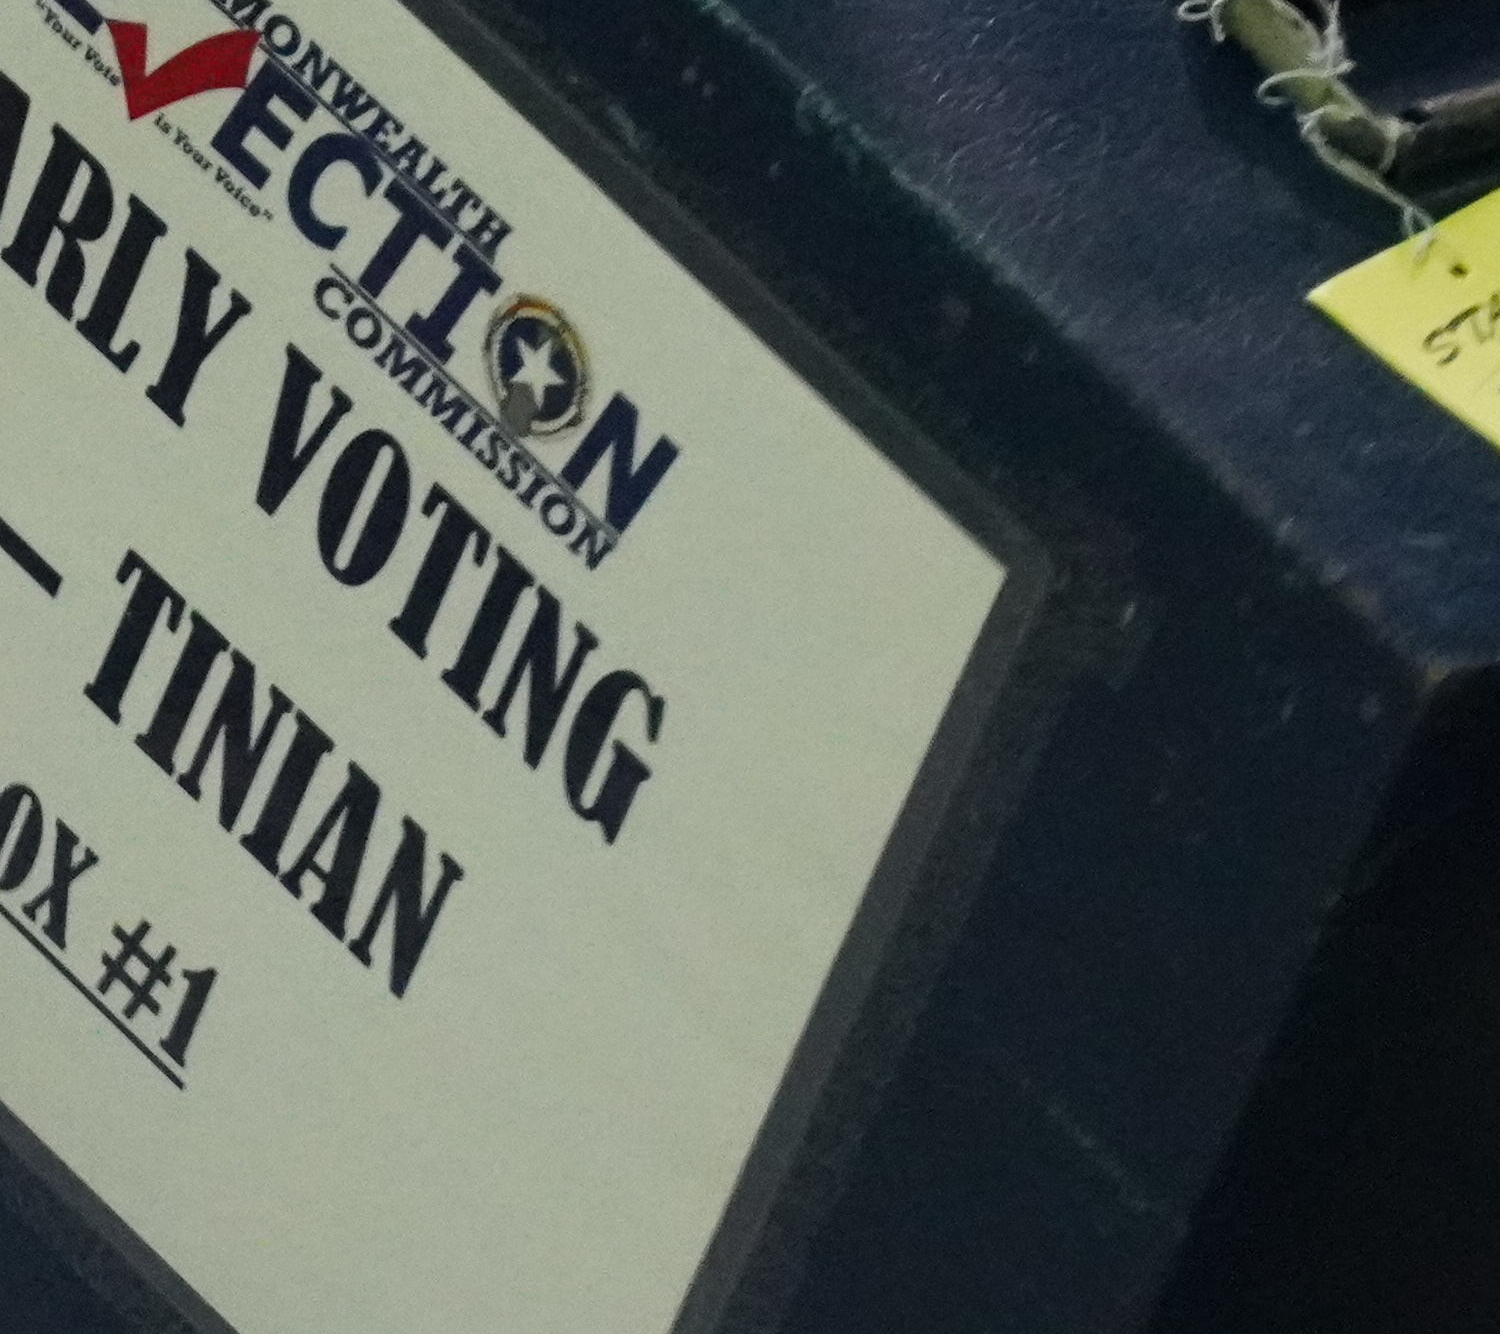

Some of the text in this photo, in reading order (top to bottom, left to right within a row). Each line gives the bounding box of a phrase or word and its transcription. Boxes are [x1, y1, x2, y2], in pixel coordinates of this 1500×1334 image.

[83, 44, 121, 88] Vote
[173, 127, 214, 172] Your
[314, 275, 620, 570] COMMISSION
[254, 342, 666, 845] VOTING
[83, 548, 464, 1001] TINIAN
[96, 919, 218, 1069] #1
